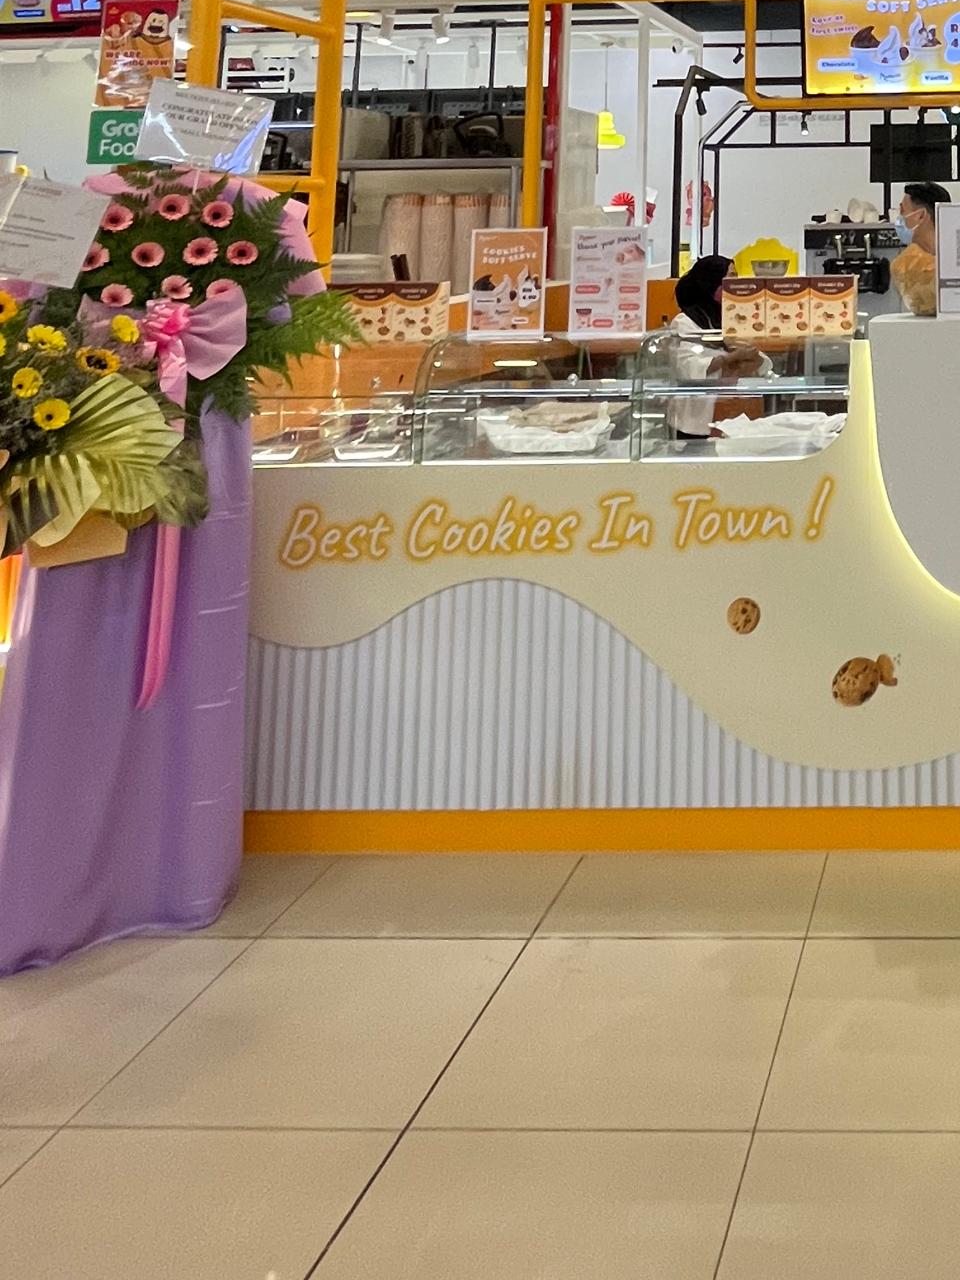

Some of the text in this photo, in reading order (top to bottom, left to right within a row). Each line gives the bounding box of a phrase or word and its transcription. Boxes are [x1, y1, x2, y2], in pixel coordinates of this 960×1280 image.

[866, 0, 911, 14] SOFT
[482, 245, 526, 257] COOKIES
[281, 506, 391, 566] Best
[406, 499, 579, 559] Cookies
[590, 494, 653, 550] In
